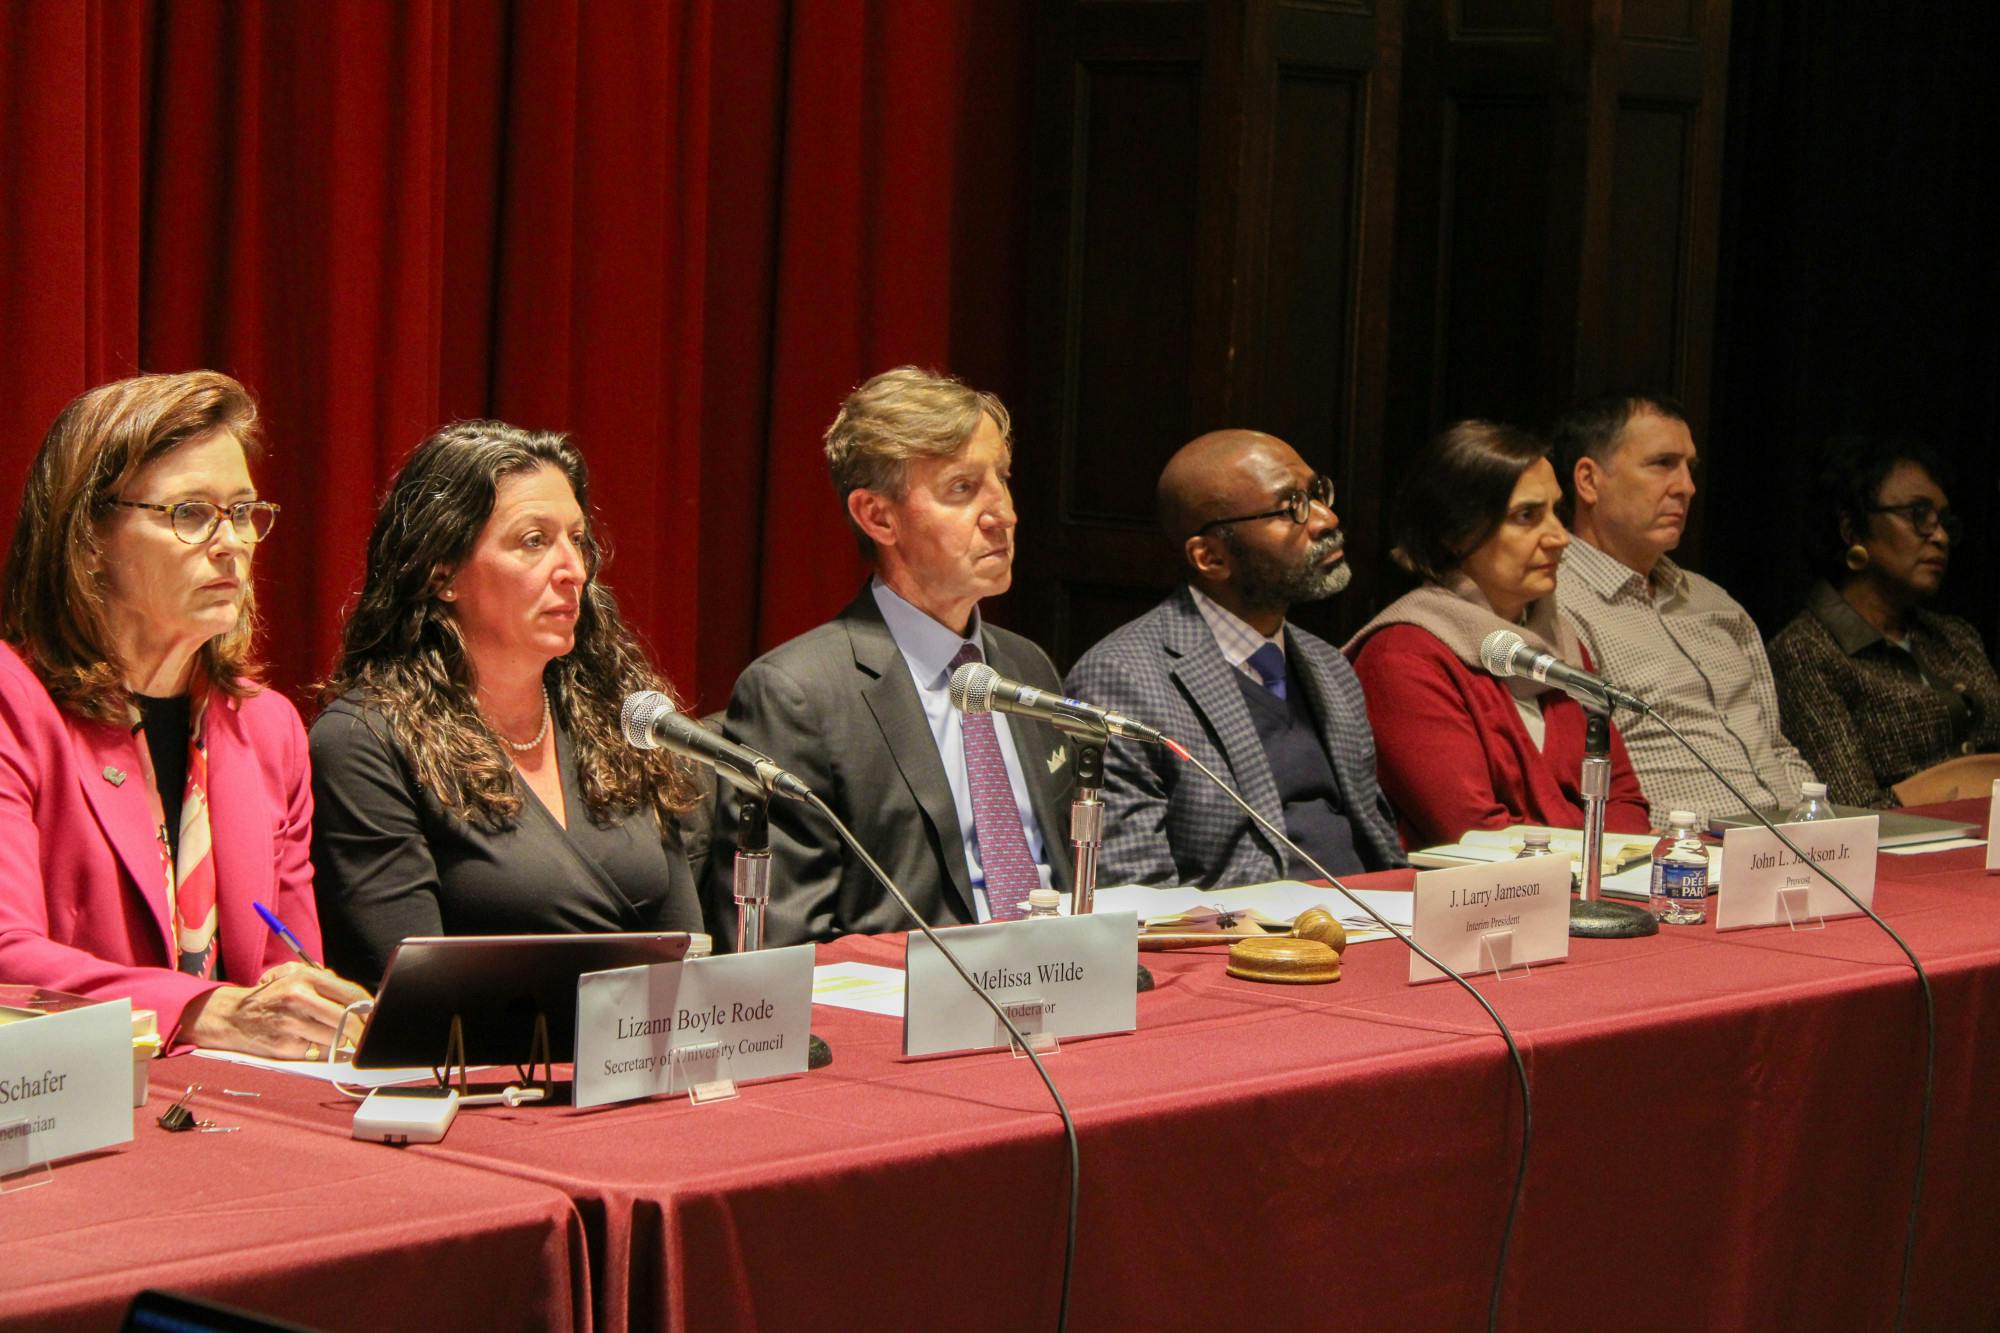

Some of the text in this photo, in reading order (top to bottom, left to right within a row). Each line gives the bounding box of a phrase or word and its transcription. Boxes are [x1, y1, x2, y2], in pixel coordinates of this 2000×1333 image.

[1751, 852, 1775, 870] John
[1779, 850, 1789, 866] L.
[1838, 843, 1850, 860] Jr.
[1449, 882, 1540, 908] J. Larry Jameson
[1466, 915, 1520, 932] Interim President
[971, 962, 1084, 991] Melissa Wilde
[617, 999, 775, 1040] Lizann Boyle Rode
[604, 1056, 656, 1076] Secretary
[660, 1049, 673, 1066] of
[739, 1034, 783, 1054] Council
[0, 1070, 67, 1105] Schafer
